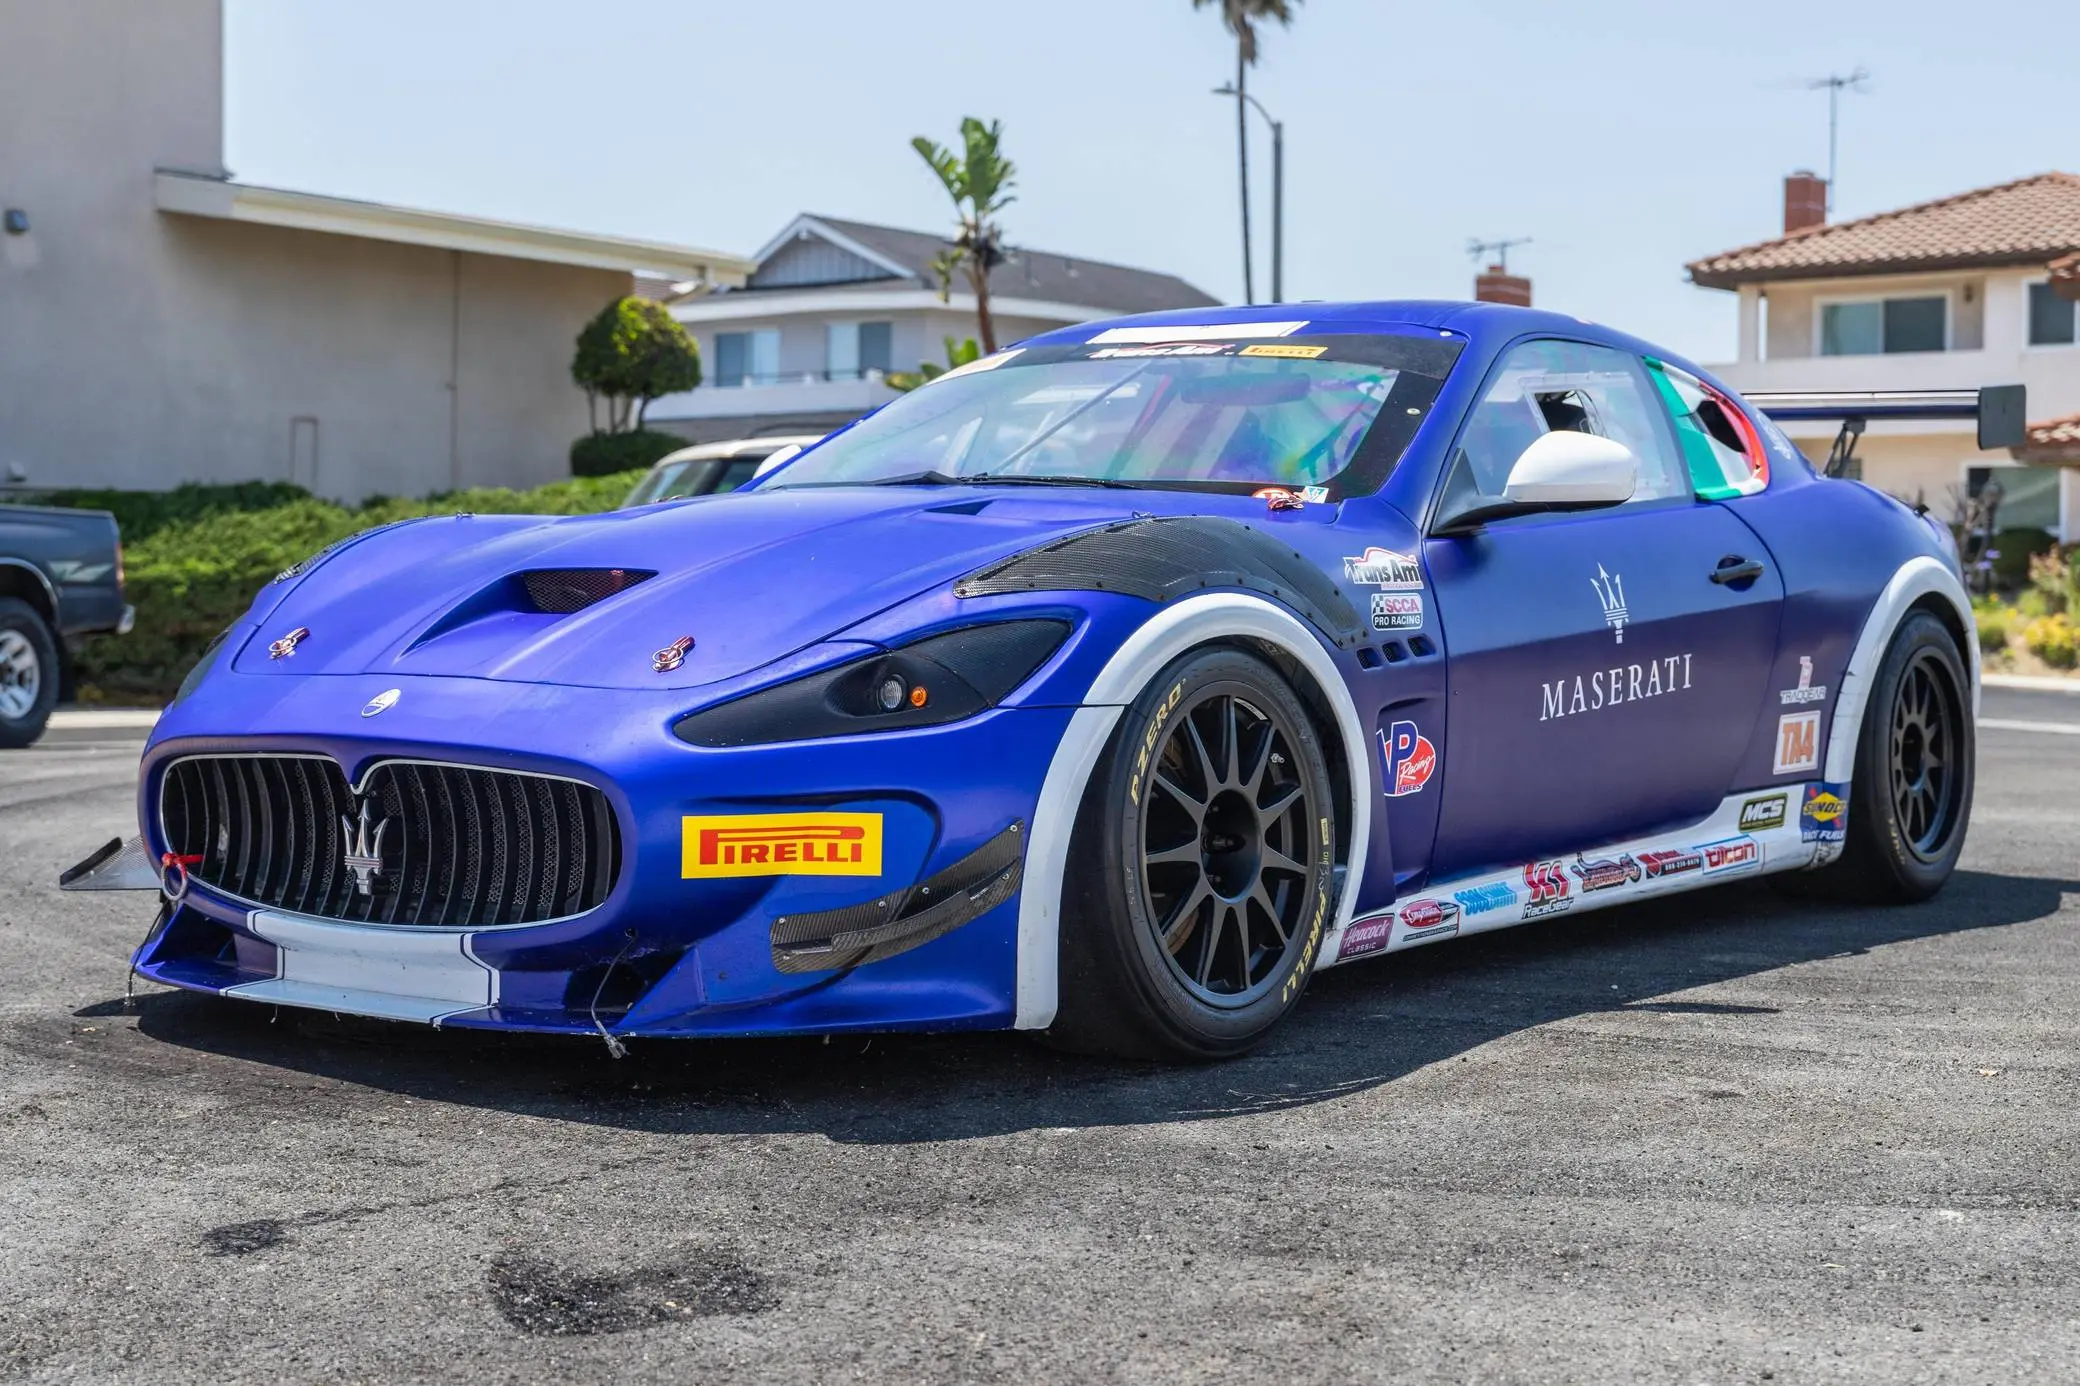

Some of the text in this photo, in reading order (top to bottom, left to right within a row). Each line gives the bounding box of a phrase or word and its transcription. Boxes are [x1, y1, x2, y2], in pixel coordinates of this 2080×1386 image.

[1389, 559, 1421, 583] Am
[1384, 597, 1420, 613] SCCA
[1374, 615, 1421, 626] PRO RACING
[1539, 653, 1692, 721] MASERATI
[1376, 720, 1419, 796] VP
[1400, 755, 1435, 785] Racing
[1742, 799, 1785, 823] MCS
[700, 826, 865, 865] PIRELLI
[1522, 897, 1574, 919] RaceGear
[1283, 892, 1327, 1003] PIRELLI
[1344, 919, 1391, 949] Heacock
[1346, 941, 1377, 954] CLASSIC
